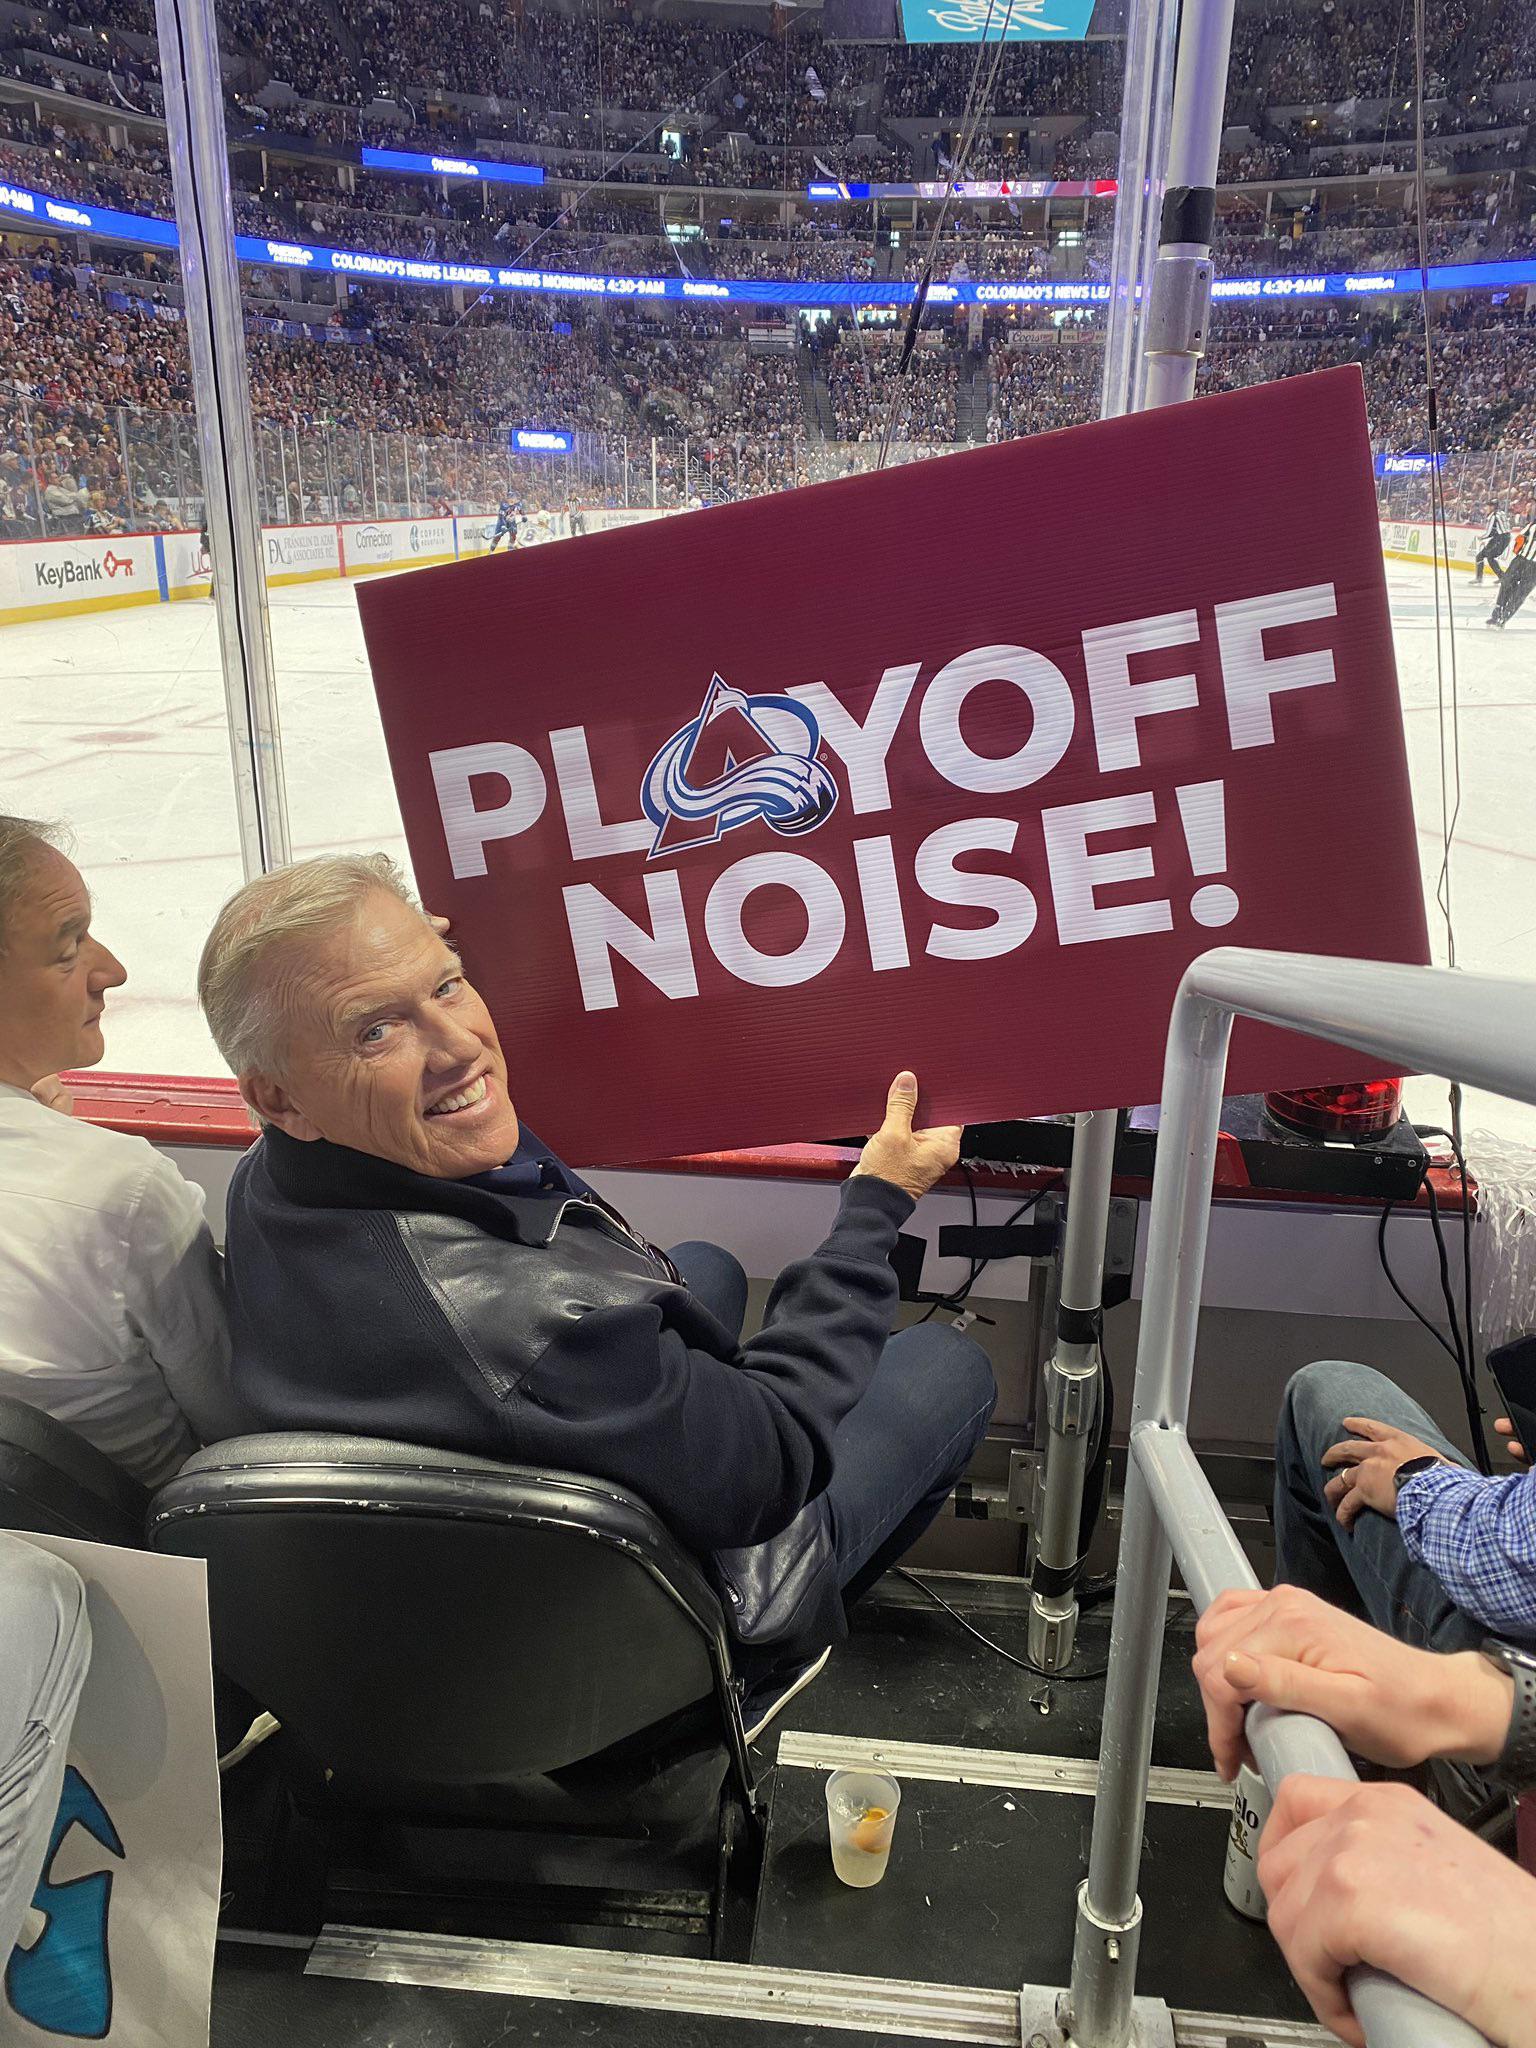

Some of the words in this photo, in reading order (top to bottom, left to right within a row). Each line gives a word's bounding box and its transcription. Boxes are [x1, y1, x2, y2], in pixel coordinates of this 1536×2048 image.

[331, 252, 406, 276] COLORADO'S
[406, 262, 442, 280] NEWS
[498, 270, 541, 288] 9NEWS
[542, 273, 606, 292] MORNINGS
[607, 279, 665, 295] 4:30-9AM
[976, 285, 1053, 300] COLORADO'S
[1054, 285, 1089, 299] NEWS
[1263, 278, 1326, 295] 4:30-9AM
[356, 530, 393, 548] Connection
[35, 557, 103, 589] KeyBank
[561, 780, 1240, 1012] NOISE!
